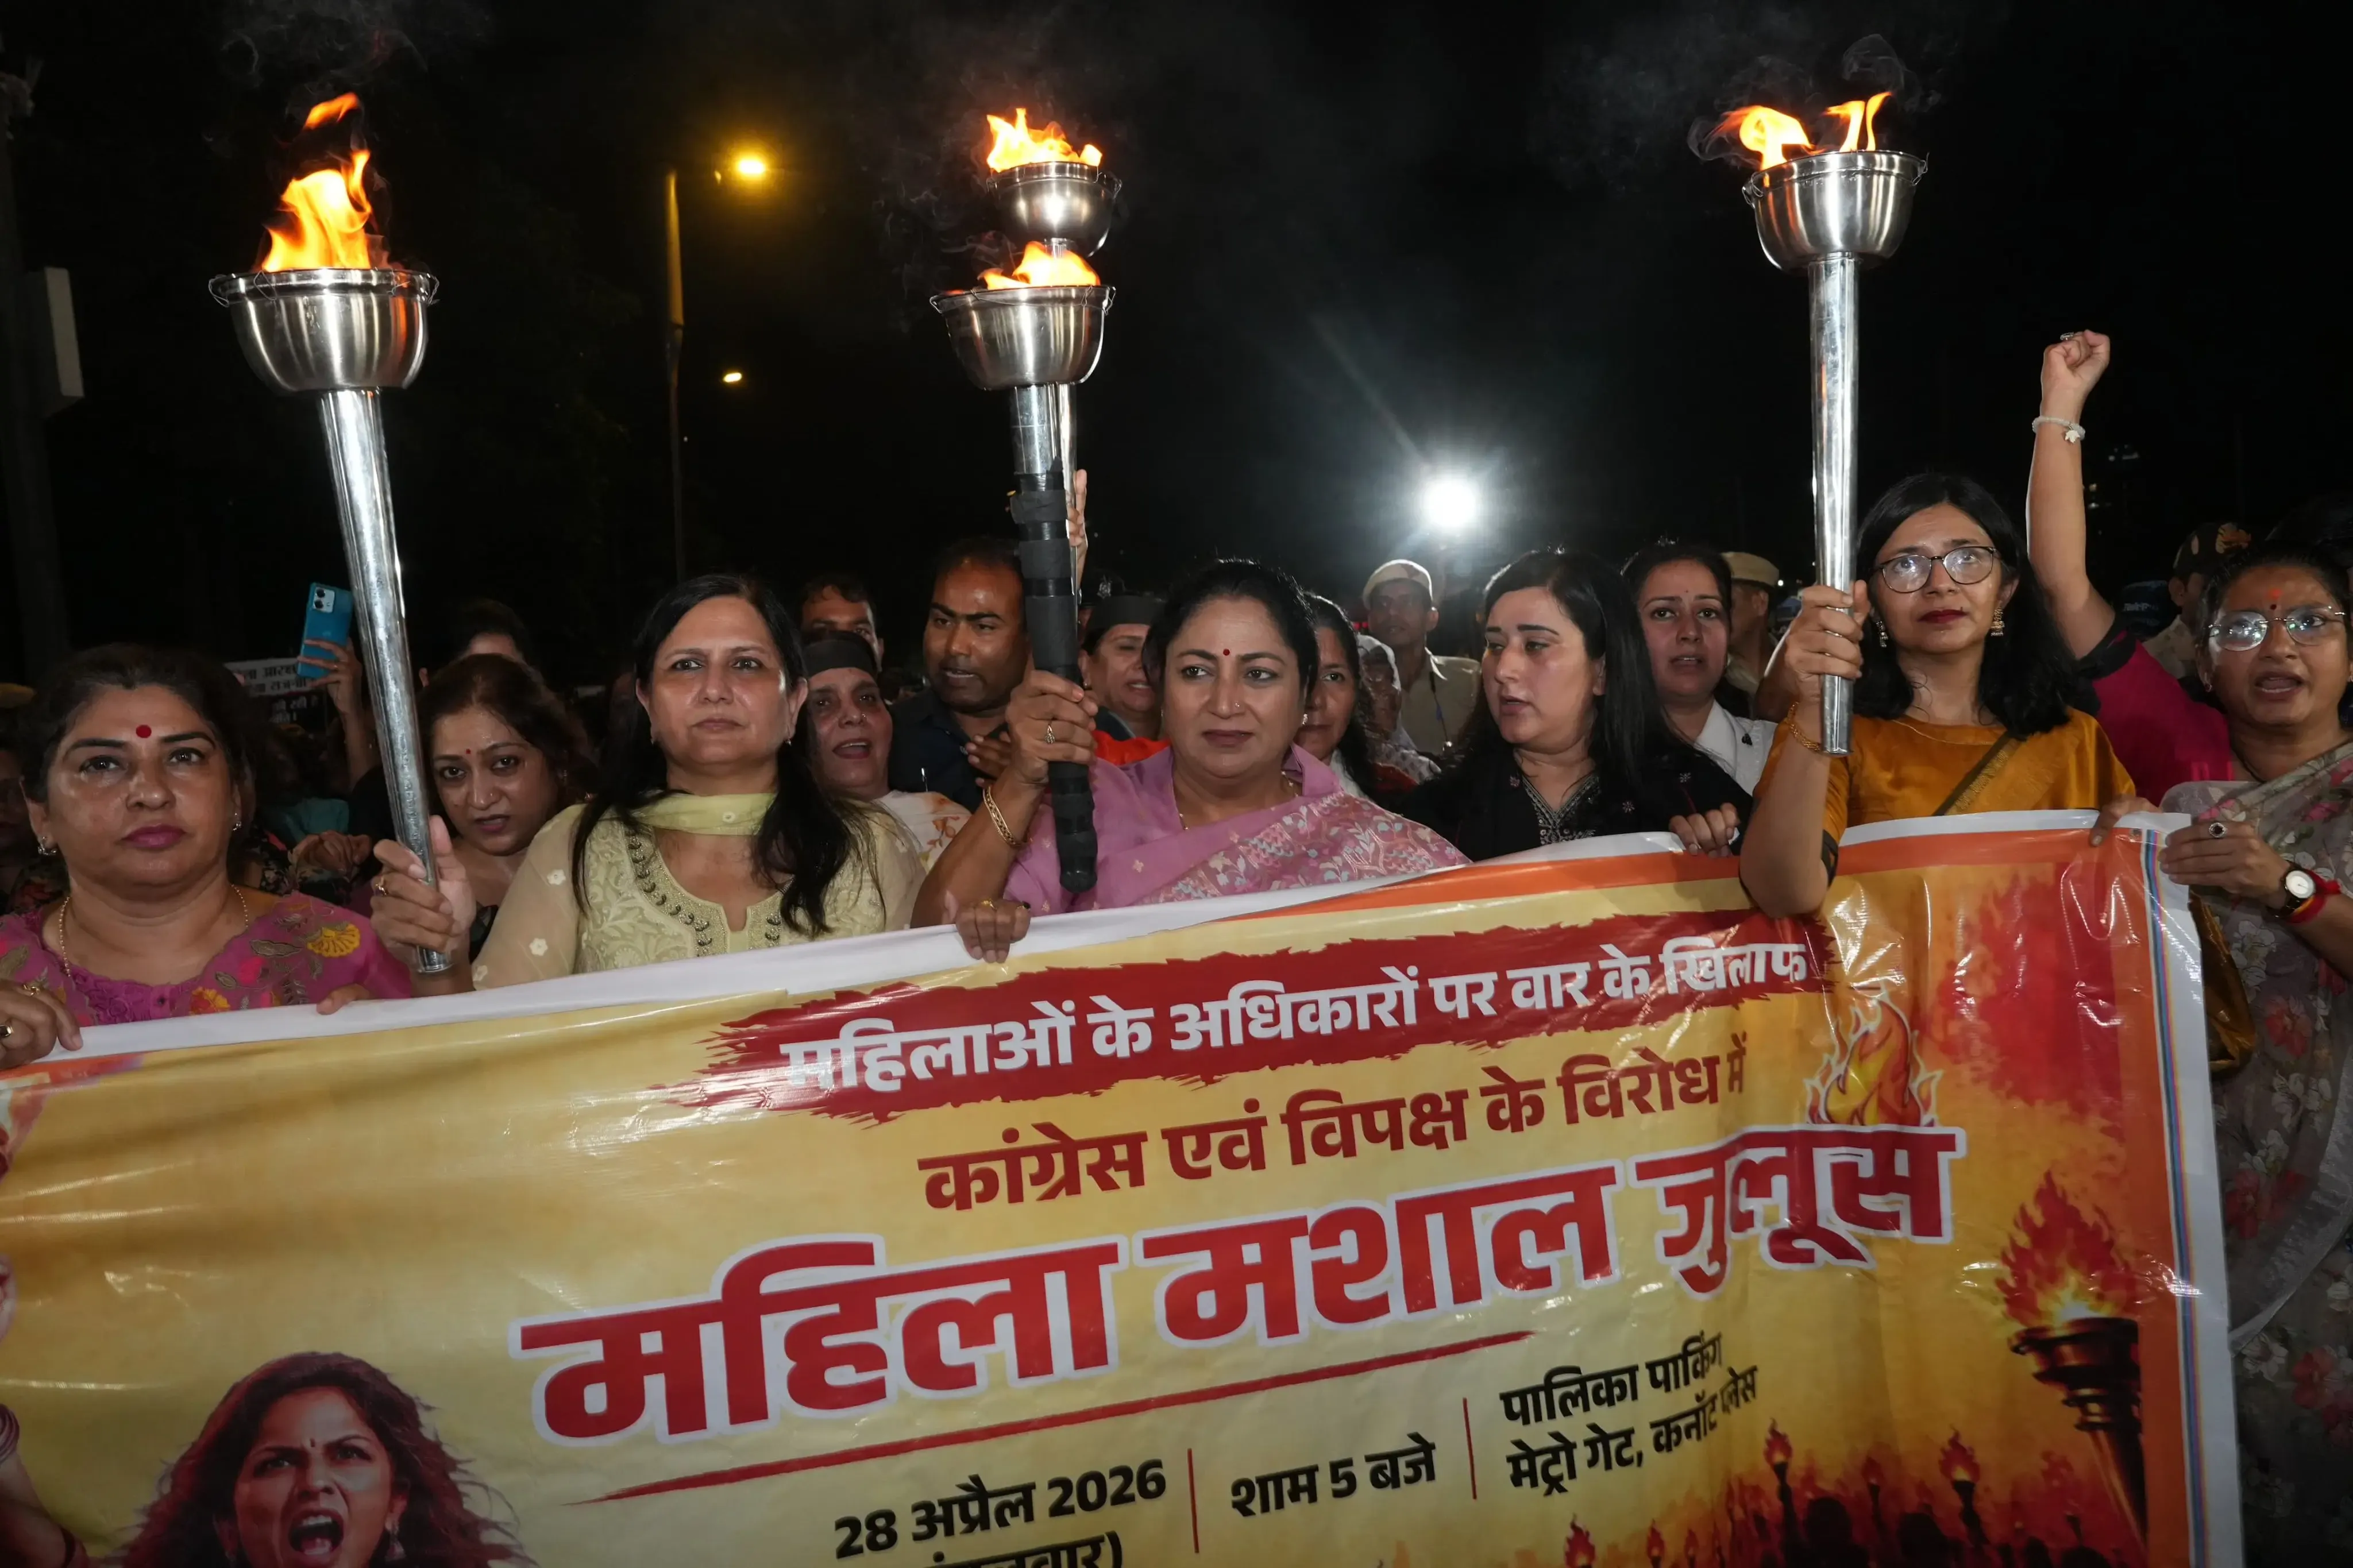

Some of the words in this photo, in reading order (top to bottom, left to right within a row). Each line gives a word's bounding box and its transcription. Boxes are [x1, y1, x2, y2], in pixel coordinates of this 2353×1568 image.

[781, 1001, 1076, 1092] महिलाओं
[1087, 995, 1154, 1059] के
[1169, 965, 1419, 1052] अधिकारों
[1428, 971, 1497, 1020] पर
[1506, 961, 1591, 1010] वार
[1599, 943, 1652, 999] के
[1658, 936, 1807, 995] खिलाफ
[917, 1122, 1148, 1211] कांग्रेस
[1160, 1097, 1267, 1180] एवं
[1279, 1088, 1468, 1166] विपक्ष
[1479, 1065, 1546, 1134] के
[1556, 1045, 1721, 1124] विरोध
[1726, 1031, 1747, 1095] में
[519, 1239, 1120, 1439] महिला
[1141, 1165, 1617, 1340] मशाल
[1634, 1128, 1957, 1295] जुलूस
[1499, 1365, 1639, 1427] पालिका
[1506, 1431, 1577, 1497] मेट्रो
[1583, 1422, 1644, 1468] गेट,
[1649, 1389, 1718, 1453] कनॉट
[834, 1508, 898, 1559] 28
[911, 1474, 1036, 1542] अप्रैल
[1047, 1458, 1166, 1518] 2026
[1230, 1463, 1319, 1517] शाम
[1329, 1459, 1357, 1500] 5
[1364, 1431, 1437, 1490] बजे
